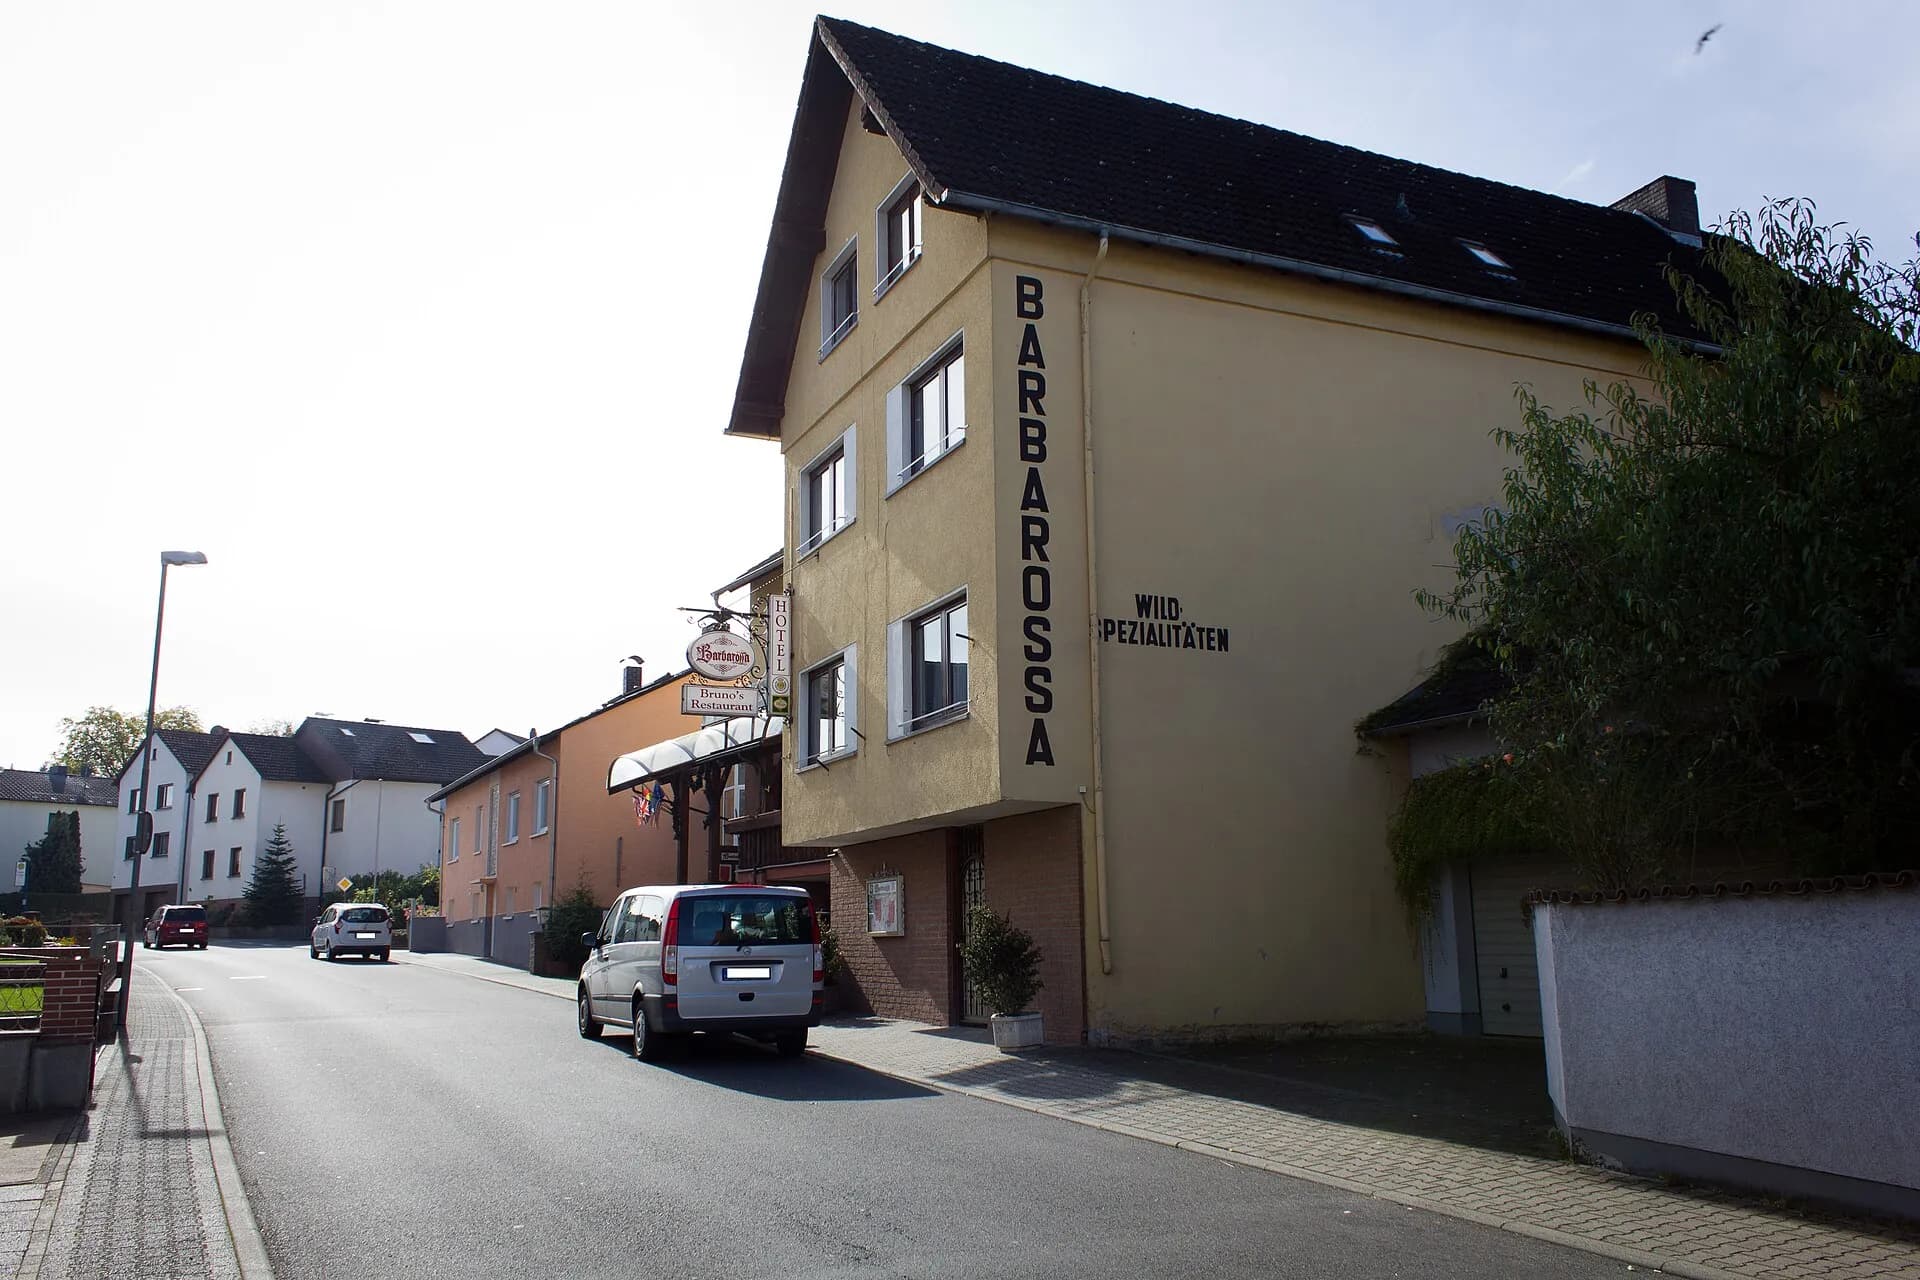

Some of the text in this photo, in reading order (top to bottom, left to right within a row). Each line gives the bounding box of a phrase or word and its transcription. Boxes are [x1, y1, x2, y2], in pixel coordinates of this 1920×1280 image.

[1016, 275, 1055, 766] BARBAROSSA
[775, 600, 787, 672] HOTEL
[691, 699, 753, 712] Restaurant
[700, 688, 745, 700] Bruno's
